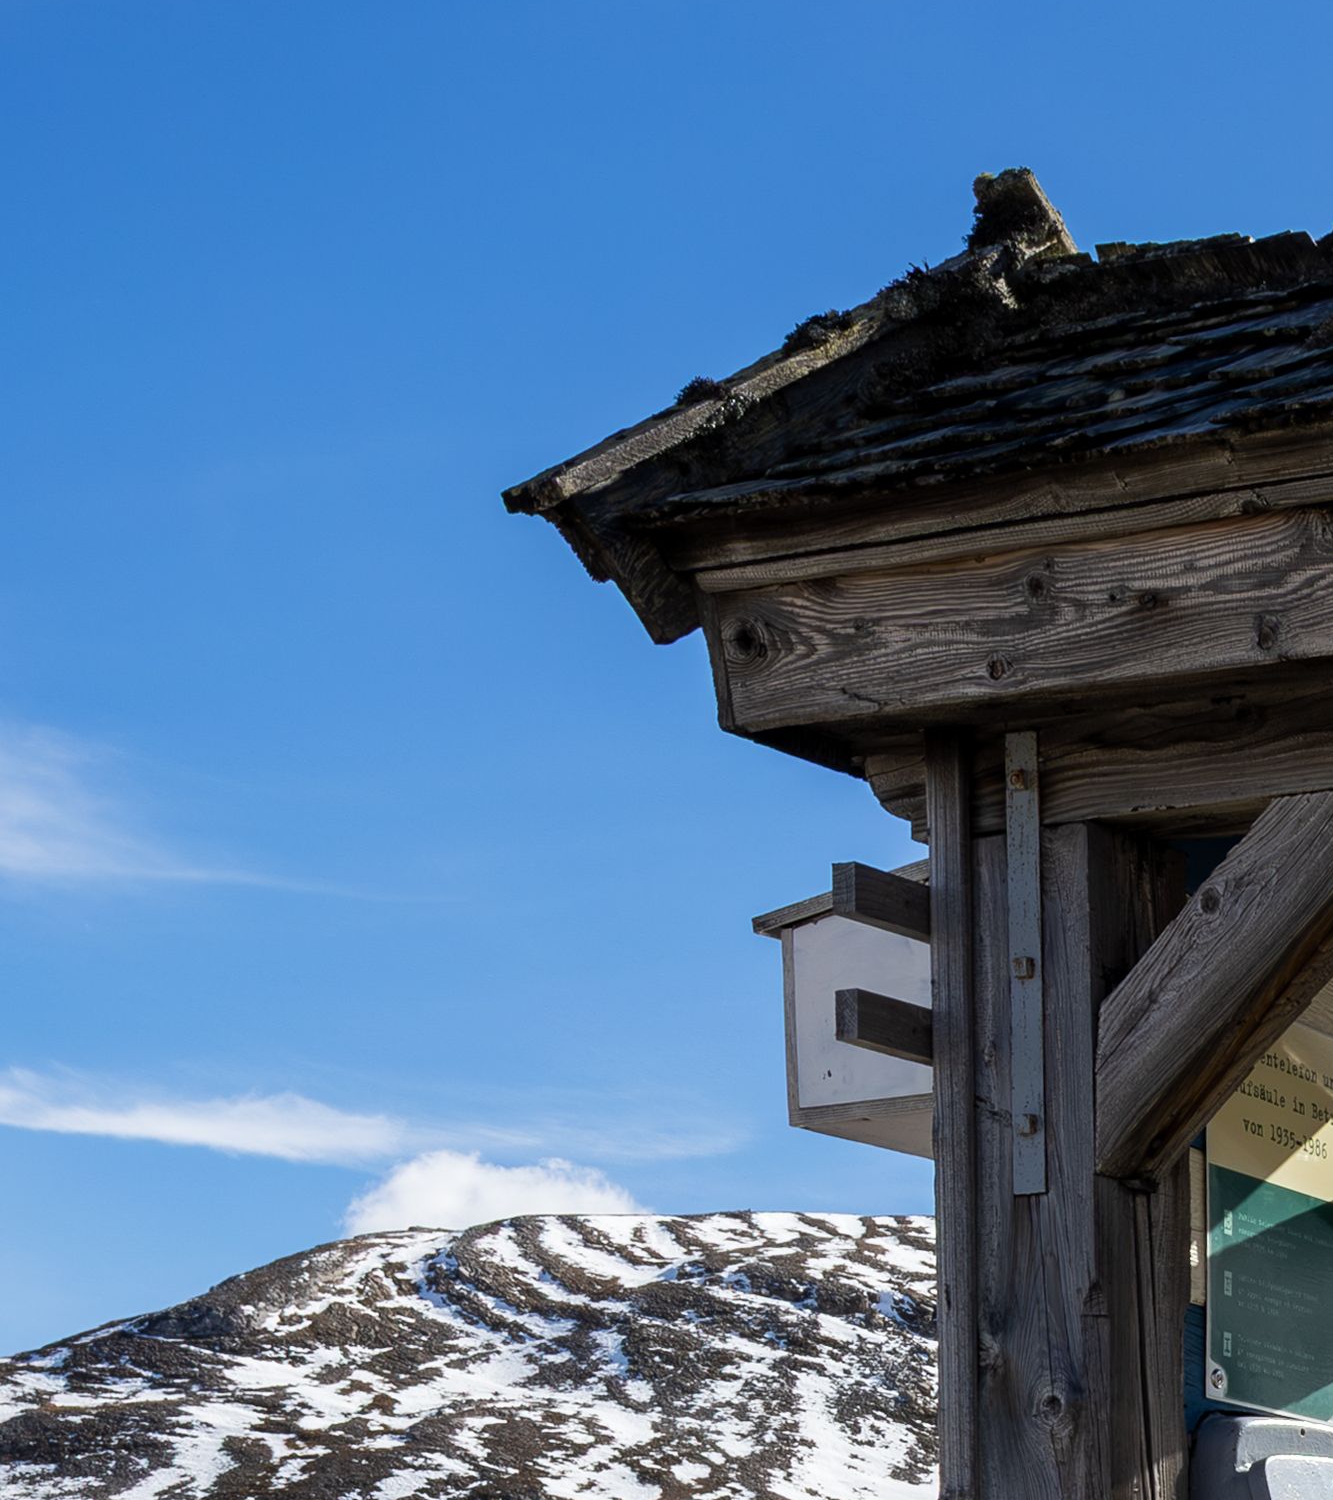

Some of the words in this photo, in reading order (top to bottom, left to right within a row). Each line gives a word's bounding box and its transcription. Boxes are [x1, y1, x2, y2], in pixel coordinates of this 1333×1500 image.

[1260, 1053, 1318, 1084] entelefon
[1235, 1080, 1286, 1109] ufsäule
[1293, 1096, 1305, 1116] in
[1243, 1118, 1264, 1138] von
[1270, 1124, 1328, 1160] 1935-1986
